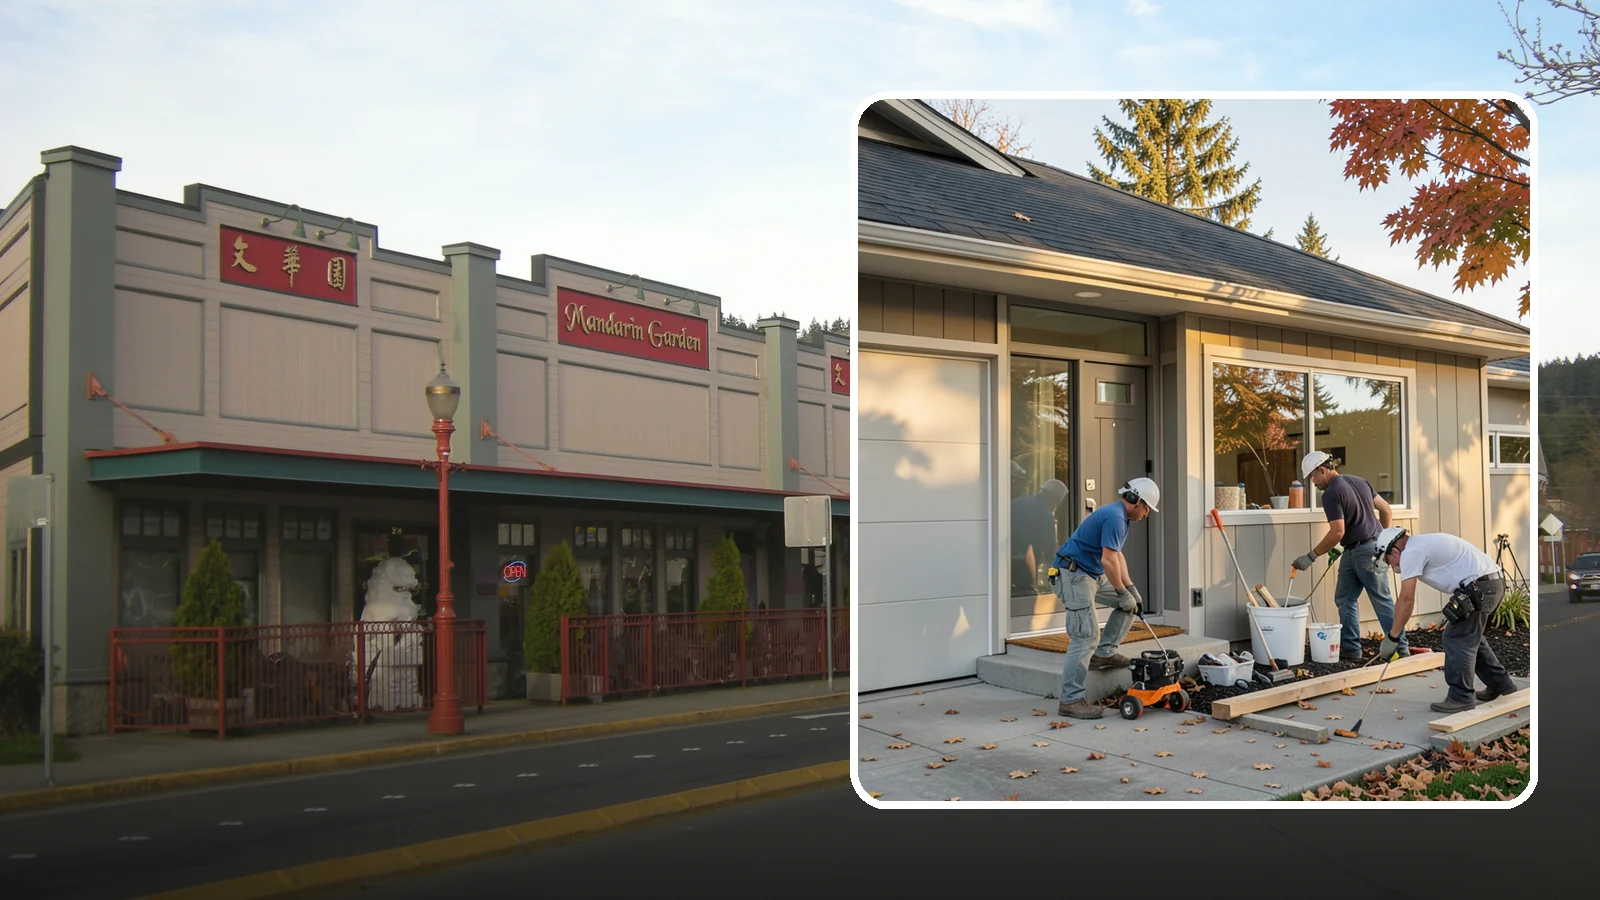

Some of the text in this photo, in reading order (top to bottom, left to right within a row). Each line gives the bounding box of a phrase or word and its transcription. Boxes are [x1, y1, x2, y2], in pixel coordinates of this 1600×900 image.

[230, 235, 346, 291] 文華園
[564, 302, 702, 352] Mandarin Garden
[835, 363, 846, 386] 文
[503, 565, 527, 578] OPEN
